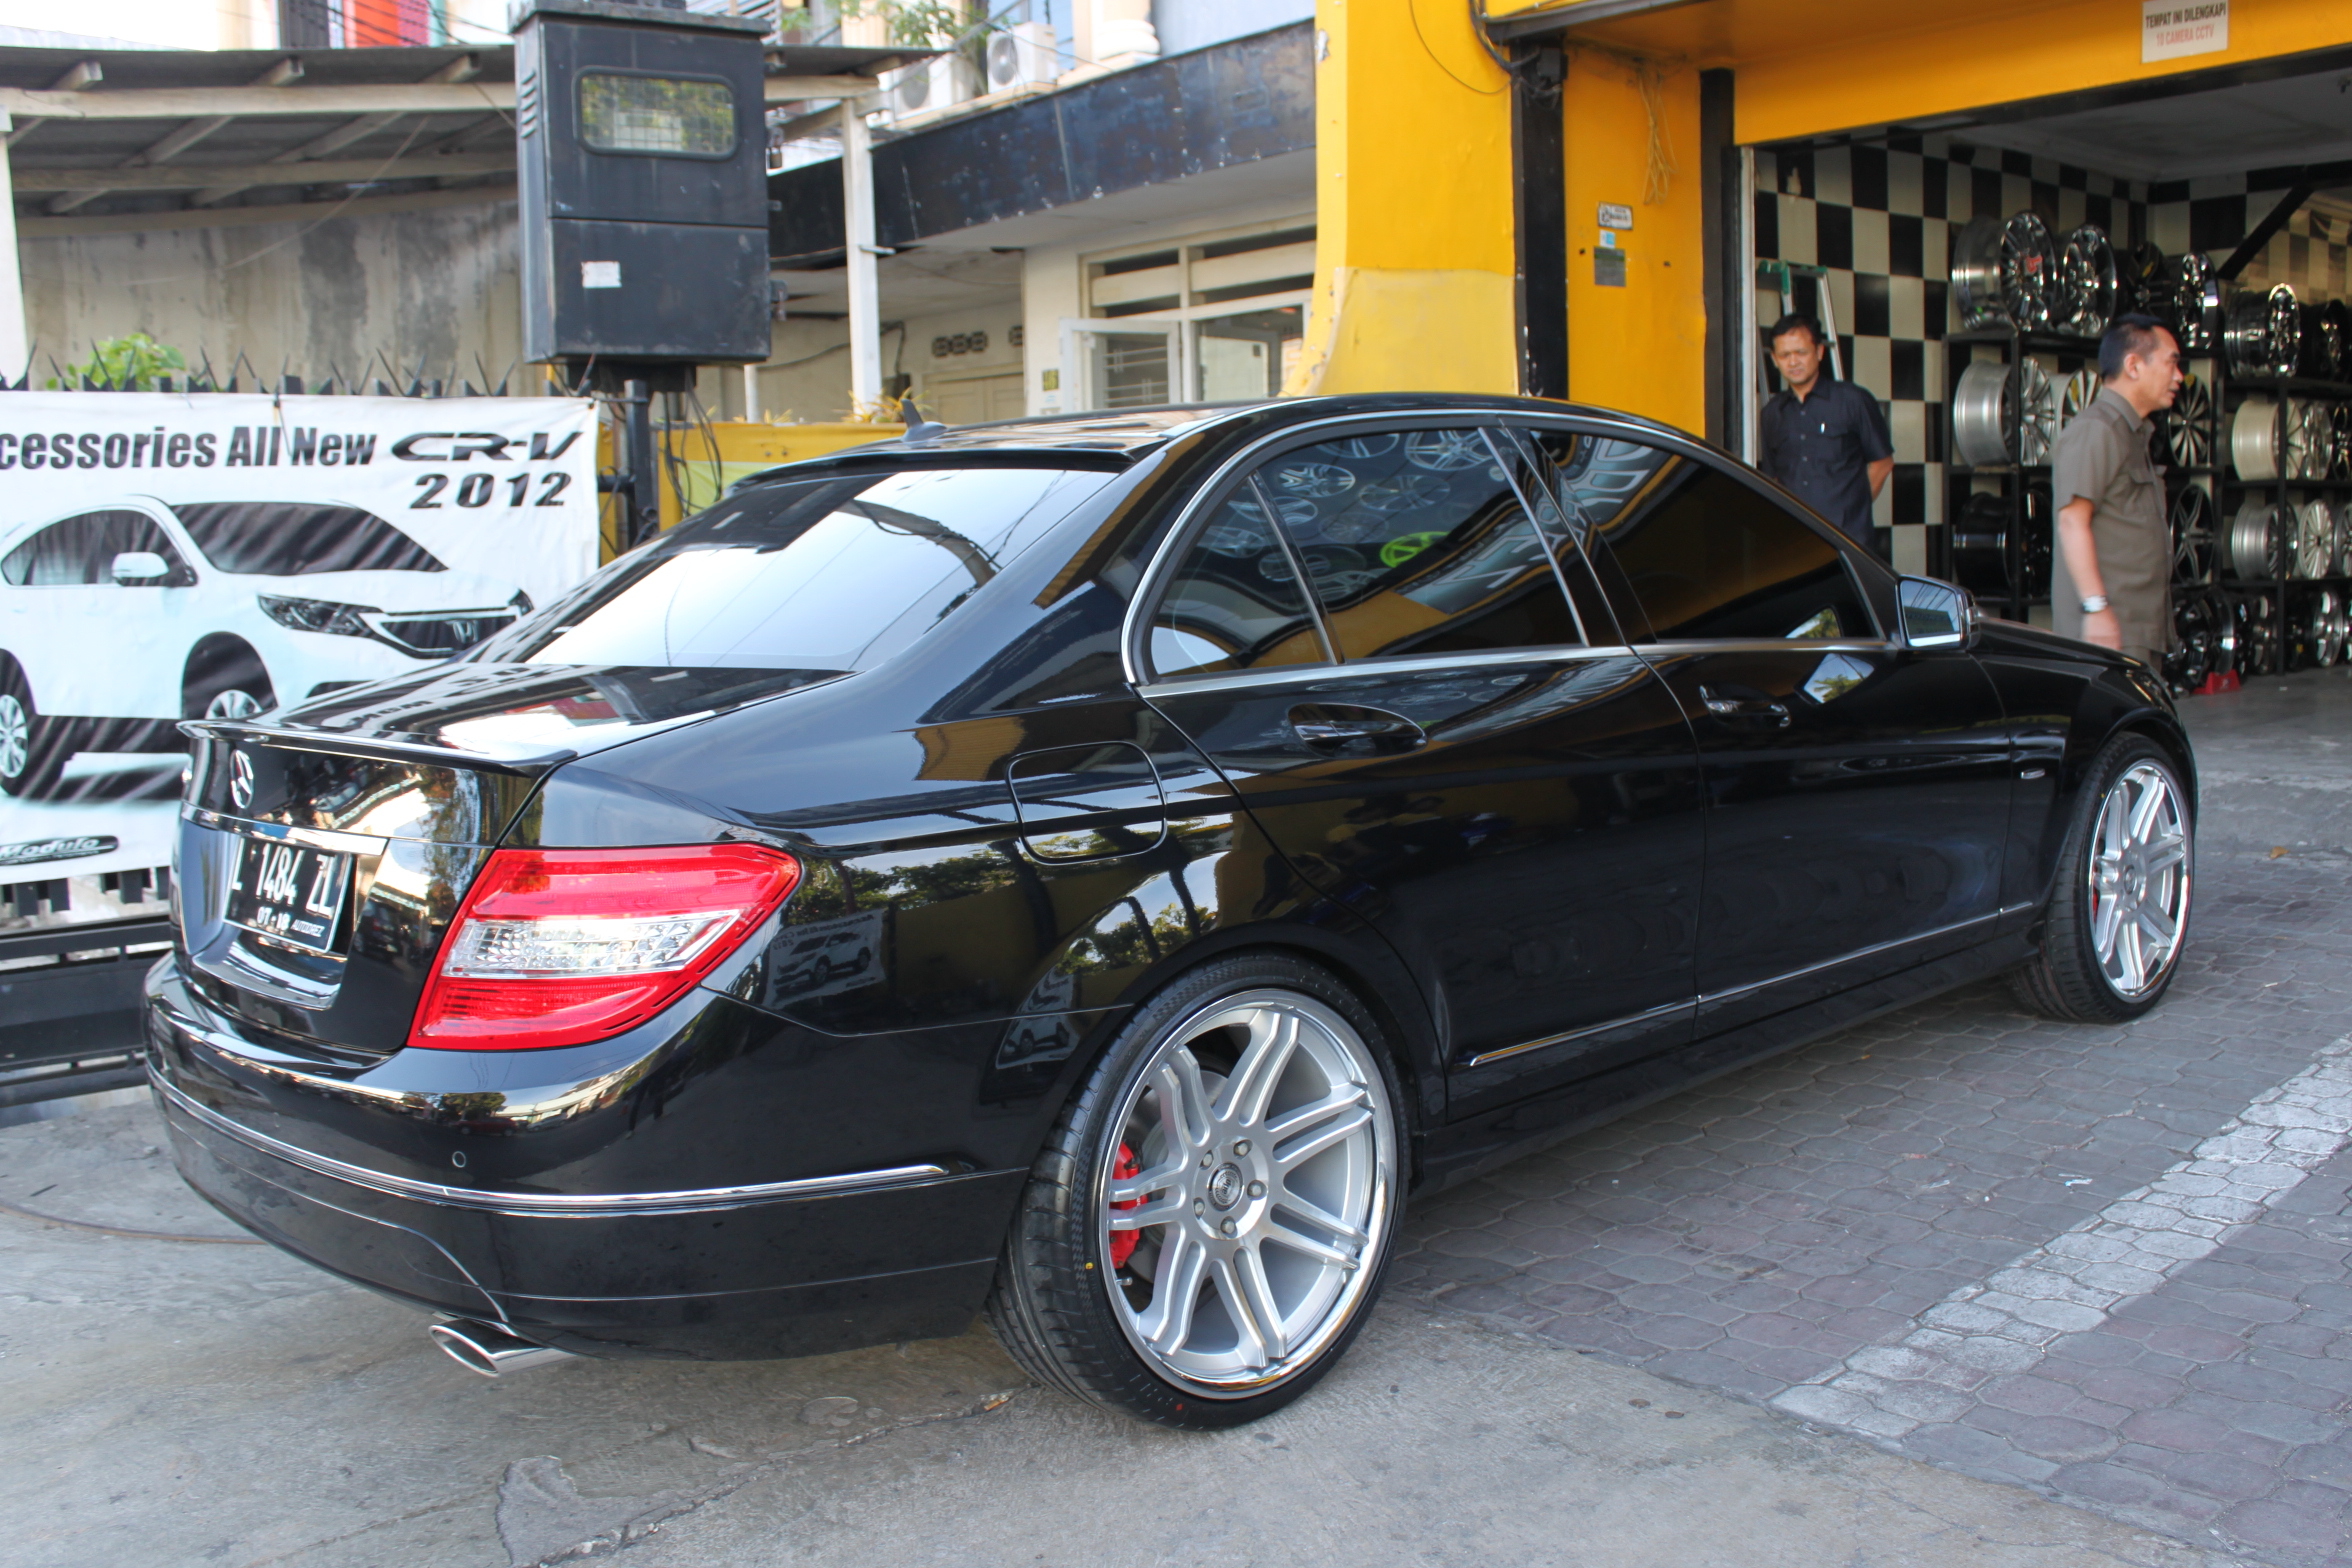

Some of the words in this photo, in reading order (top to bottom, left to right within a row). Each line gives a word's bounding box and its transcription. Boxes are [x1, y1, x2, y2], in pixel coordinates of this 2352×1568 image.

[2146, 12, 2171, 28] TEMPAT
[2173, 9, 2183, 23] INI
[2184, 3, 2226, 22] DILENGKAPI
[2166, 27, 2194, 45] CAMERA
[2196, 24, 2215, 41] CCTV
[226, 426, 282, 466] All
[291, 427, 377, 466] New
[391, 432, 584, 461] CR-V
[409, 472, 571, 509] 2012
[256, 843, 305, 905] 1484
[305, 854, 336, 917] ZL
